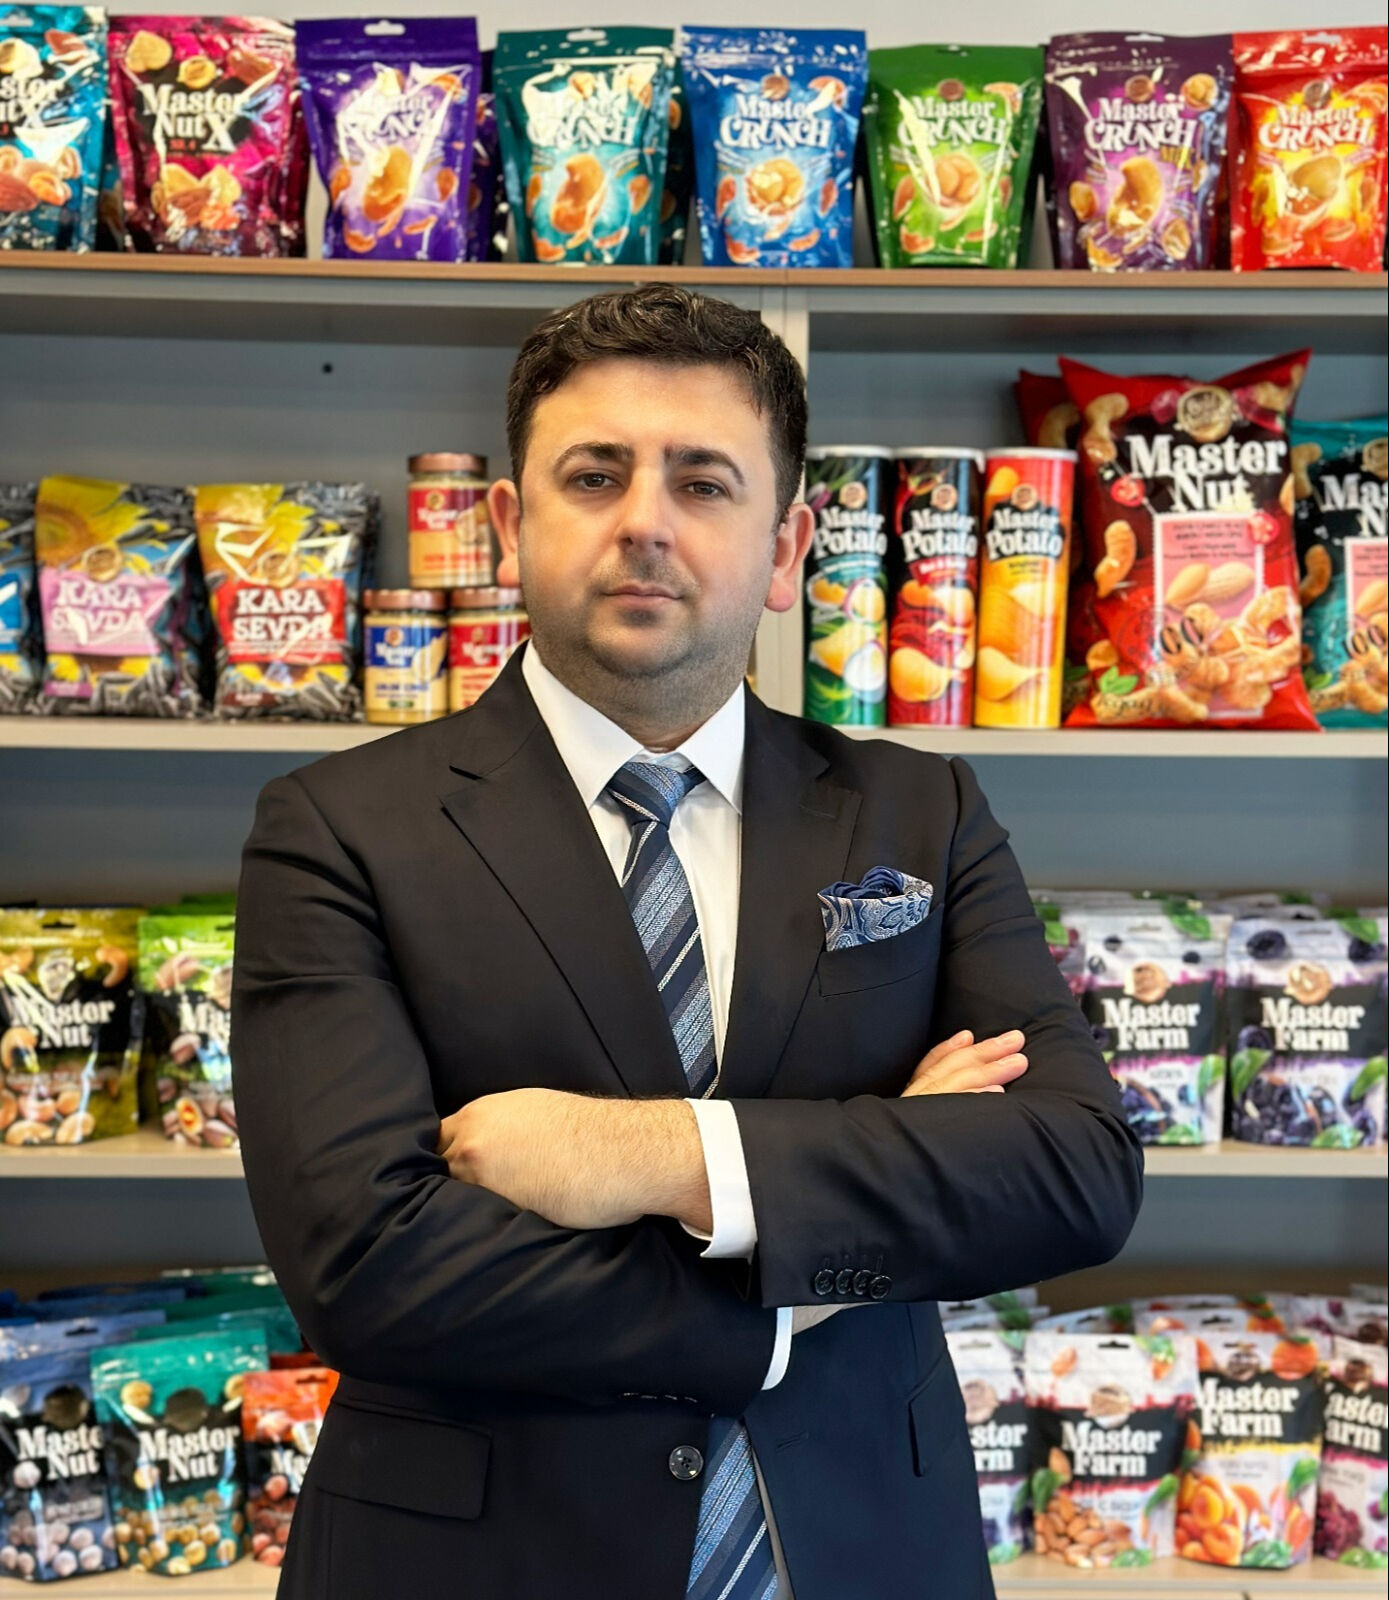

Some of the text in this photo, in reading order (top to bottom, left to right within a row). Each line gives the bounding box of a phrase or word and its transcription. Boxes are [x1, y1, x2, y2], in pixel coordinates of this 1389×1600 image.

[137, 84, 248, 116] Master
[911, 96, 996, 118] Master
[1098, 98, 1184, 122] Master
[1277, 104, 1361, 127] Master
[720, 115, 832, 150] CRUNCH
[1084, 117, 1197, 152] CRUNCH
[1258, 117, 1372, 152] CRUNCH
[1126, 434, 1287, 479] Master
[1170, 471, 1254, 513] Nut
[819, 506, 885, 531] Master
[911, 508, 976, 533] Master
[993, 508, 1059, 532] Master
[814, 527, 888, 559] Potato
[901, 531, 979, 562] Potato
[985, 530, 1064, 561] Potato
[56, 578, 142, 608] KARA
[236, 588, 325, 615] KARA
[51, 607, 148, 633] SVDA
[232, 615, 332, 641] SEVDA
[1101, 998, 1201, 1029] Master
[1260, 997, 1365, 1030] Master
[40, 1023, 93, 1049] Nut
[1117, 1025, 1190, 1051] Farm
[1275, 1025, 1350, 1051] Farm
[1197, 1376, 1299, 1413] Master
[1202, 1407, 1283, 1438] Farm
[1324, 1391, 1388, 1430] aste
[16, 1424, 103, 1460] Maste
[139, 1425, 241, 1460] Master
[970, 1420, 1028, 1449] ster
[1061, 1425, 1162, 1455] Master
[1325, 1418, 1381, 1453] arm
[48, 1450, 99, 1480] Nut
[168, 1449, 219, 1482] Nut
[973, 1448, 1014, 1472] rm
[1074, 1450, 1147, 1477] Farm
